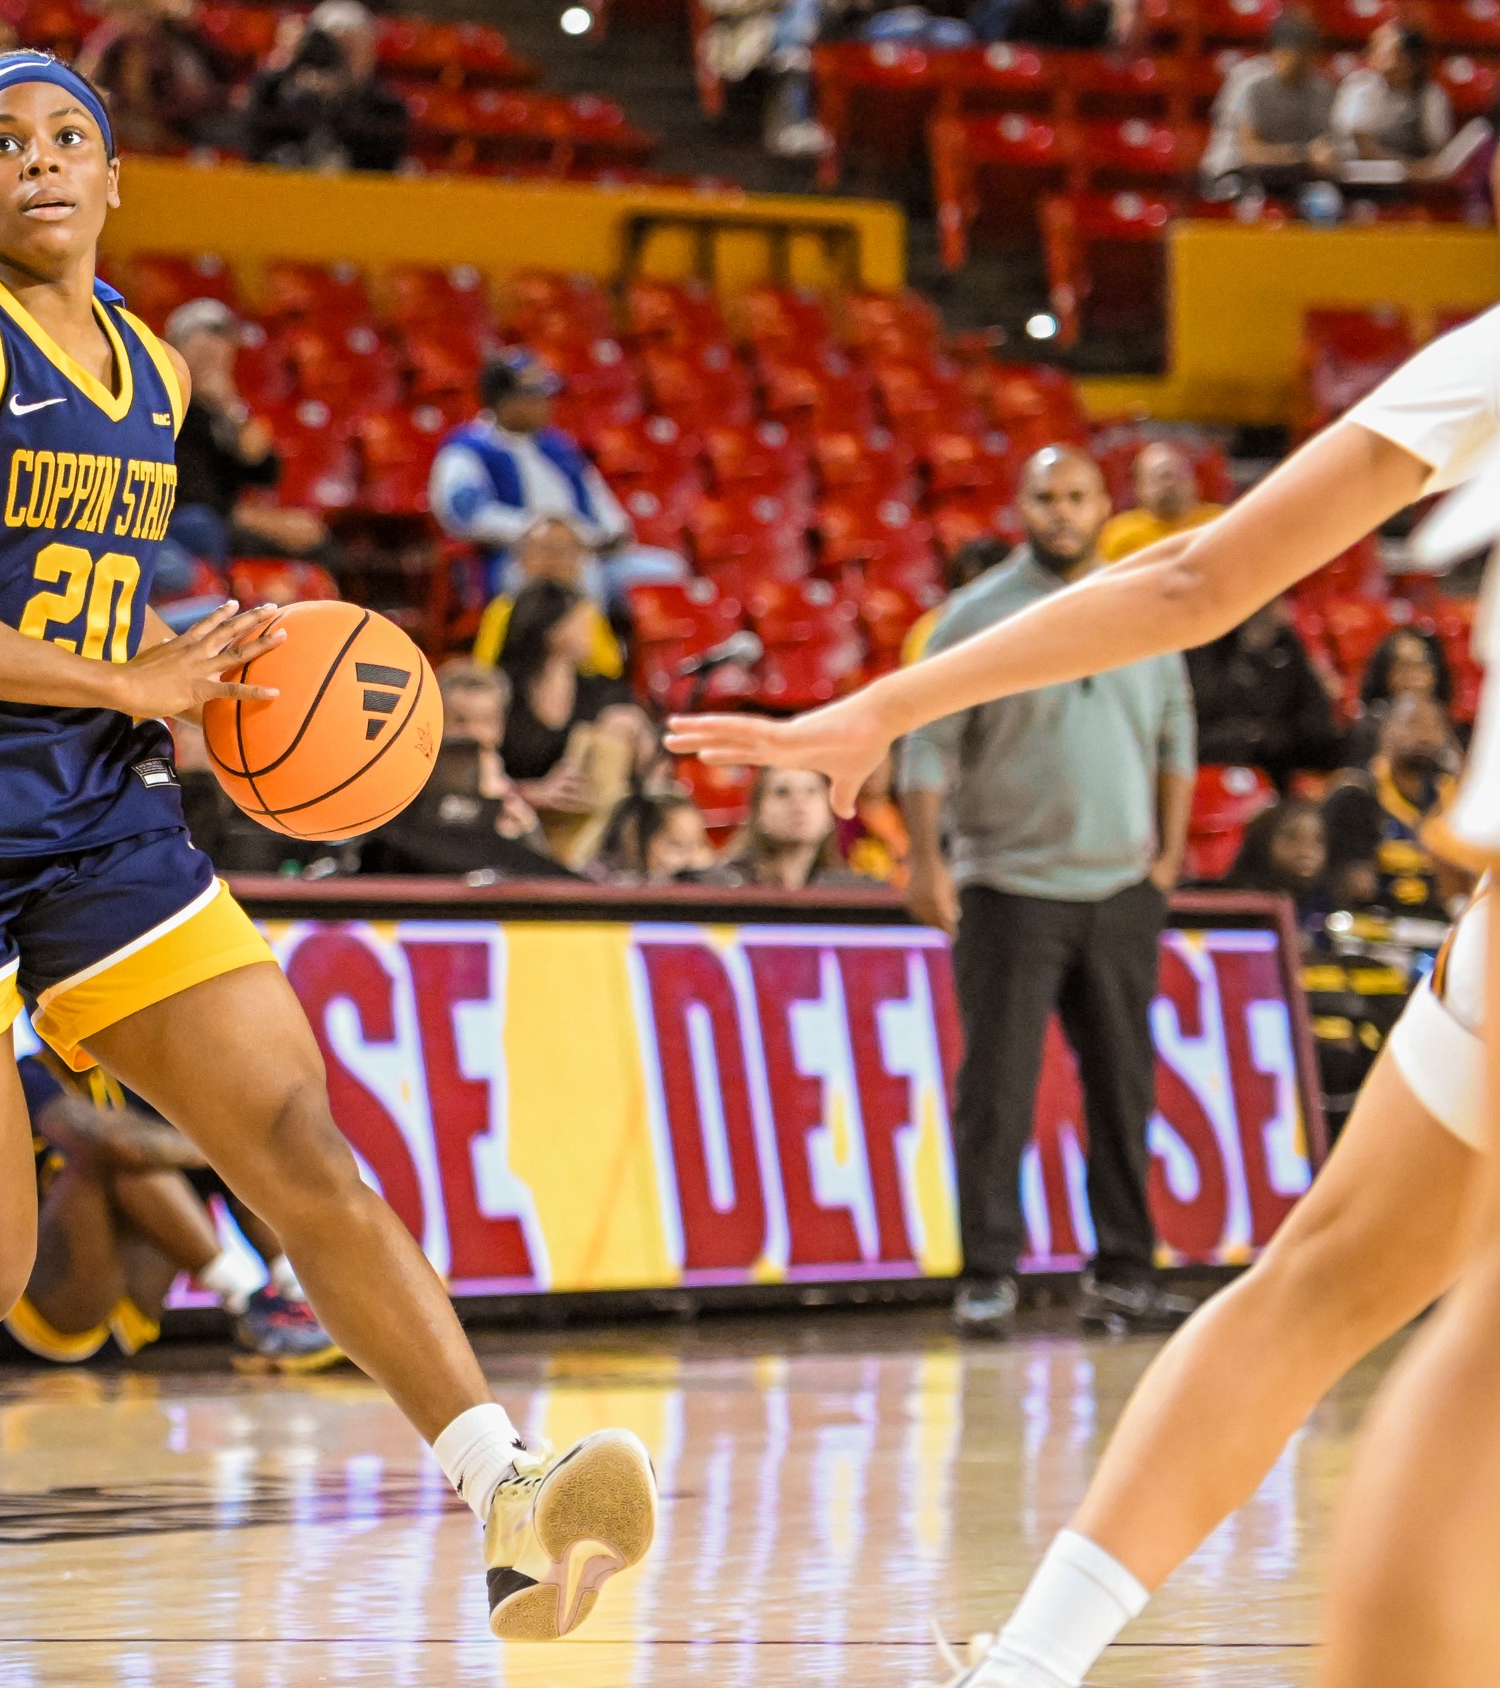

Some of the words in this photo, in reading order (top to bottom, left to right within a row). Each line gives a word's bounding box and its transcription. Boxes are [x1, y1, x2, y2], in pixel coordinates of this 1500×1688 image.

[4, 449, 122, 534] COPPIN
[114, 459, 178, 541] STAT
[18, 543, 141, 664] 20
[641, 942, 1312, 1270] DEFSE
